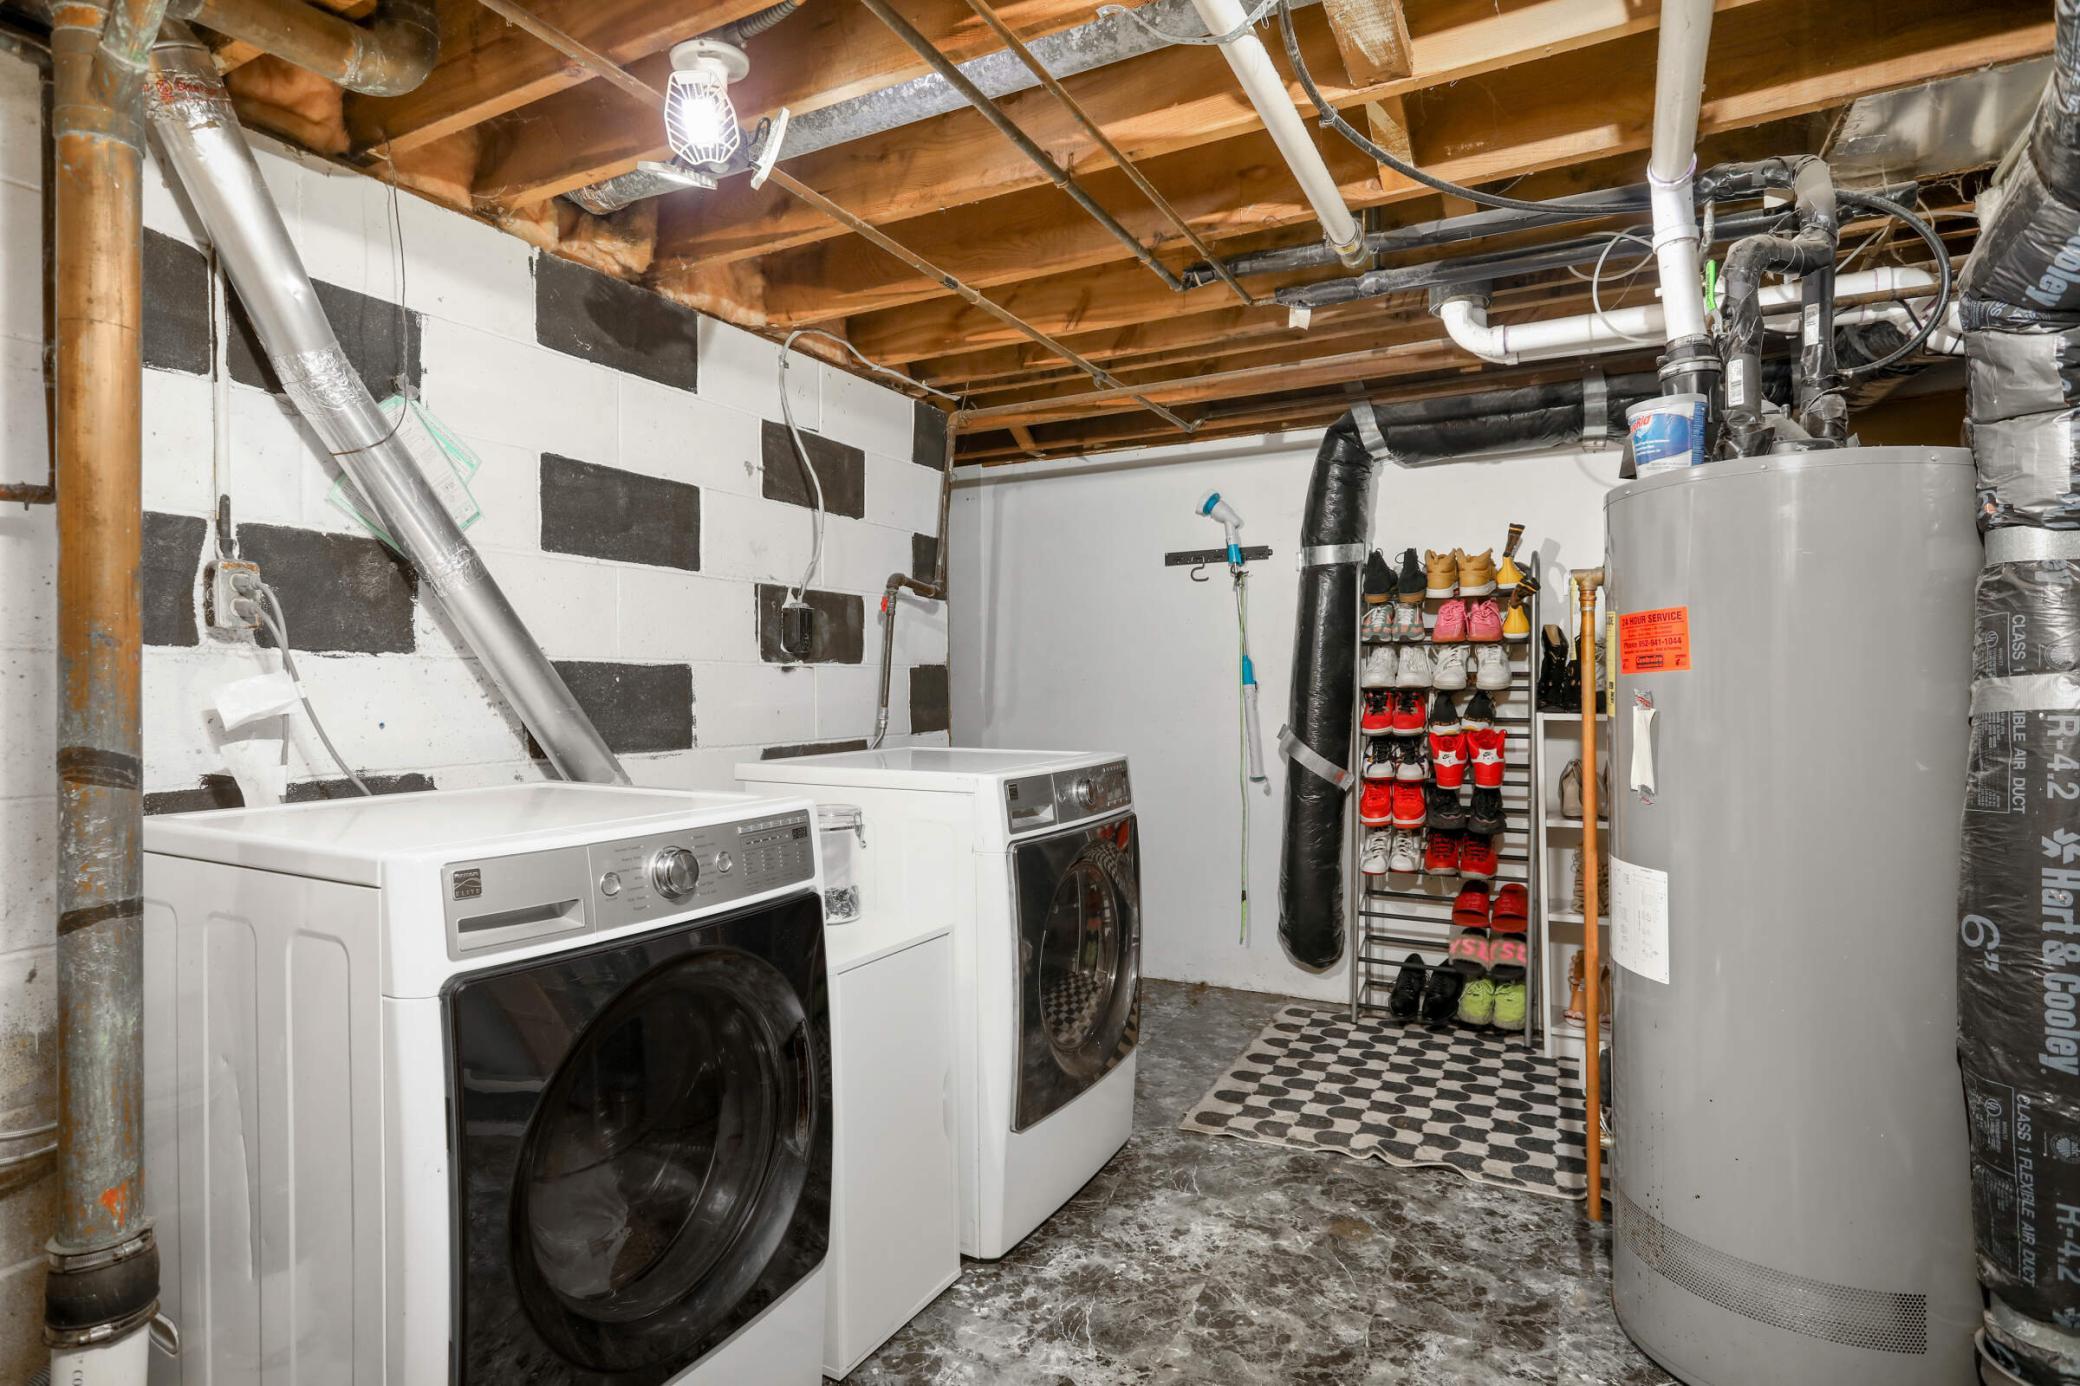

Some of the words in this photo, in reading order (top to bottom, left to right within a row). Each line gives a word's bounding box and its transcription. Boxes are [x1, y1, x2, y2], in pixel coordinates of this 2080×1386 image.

[1629, 615, 1646, 626] HOUR
[1647, 611, 1682, 624] SERVICE
[2012, 615, 2026, 660] CLASS
[2013, 747, 2026, 770] AIR
[2047, 715, 2080, 800] R-4.2
[2012, 777, 2026, 814] DUCT
[2042, 867, 2080, 935] Hart
[2041, 940, 2080, 967] &
[2039, 972, 2080, 1076] Cooley
[2016, 1094, 2032, 1141] CLASS
[2019, 1156, 2036, 1219] FLEXIBLE
[2021, 1221, 2036, 1246] AIR
[2022, 1250, 2036, 1288] DUCT
